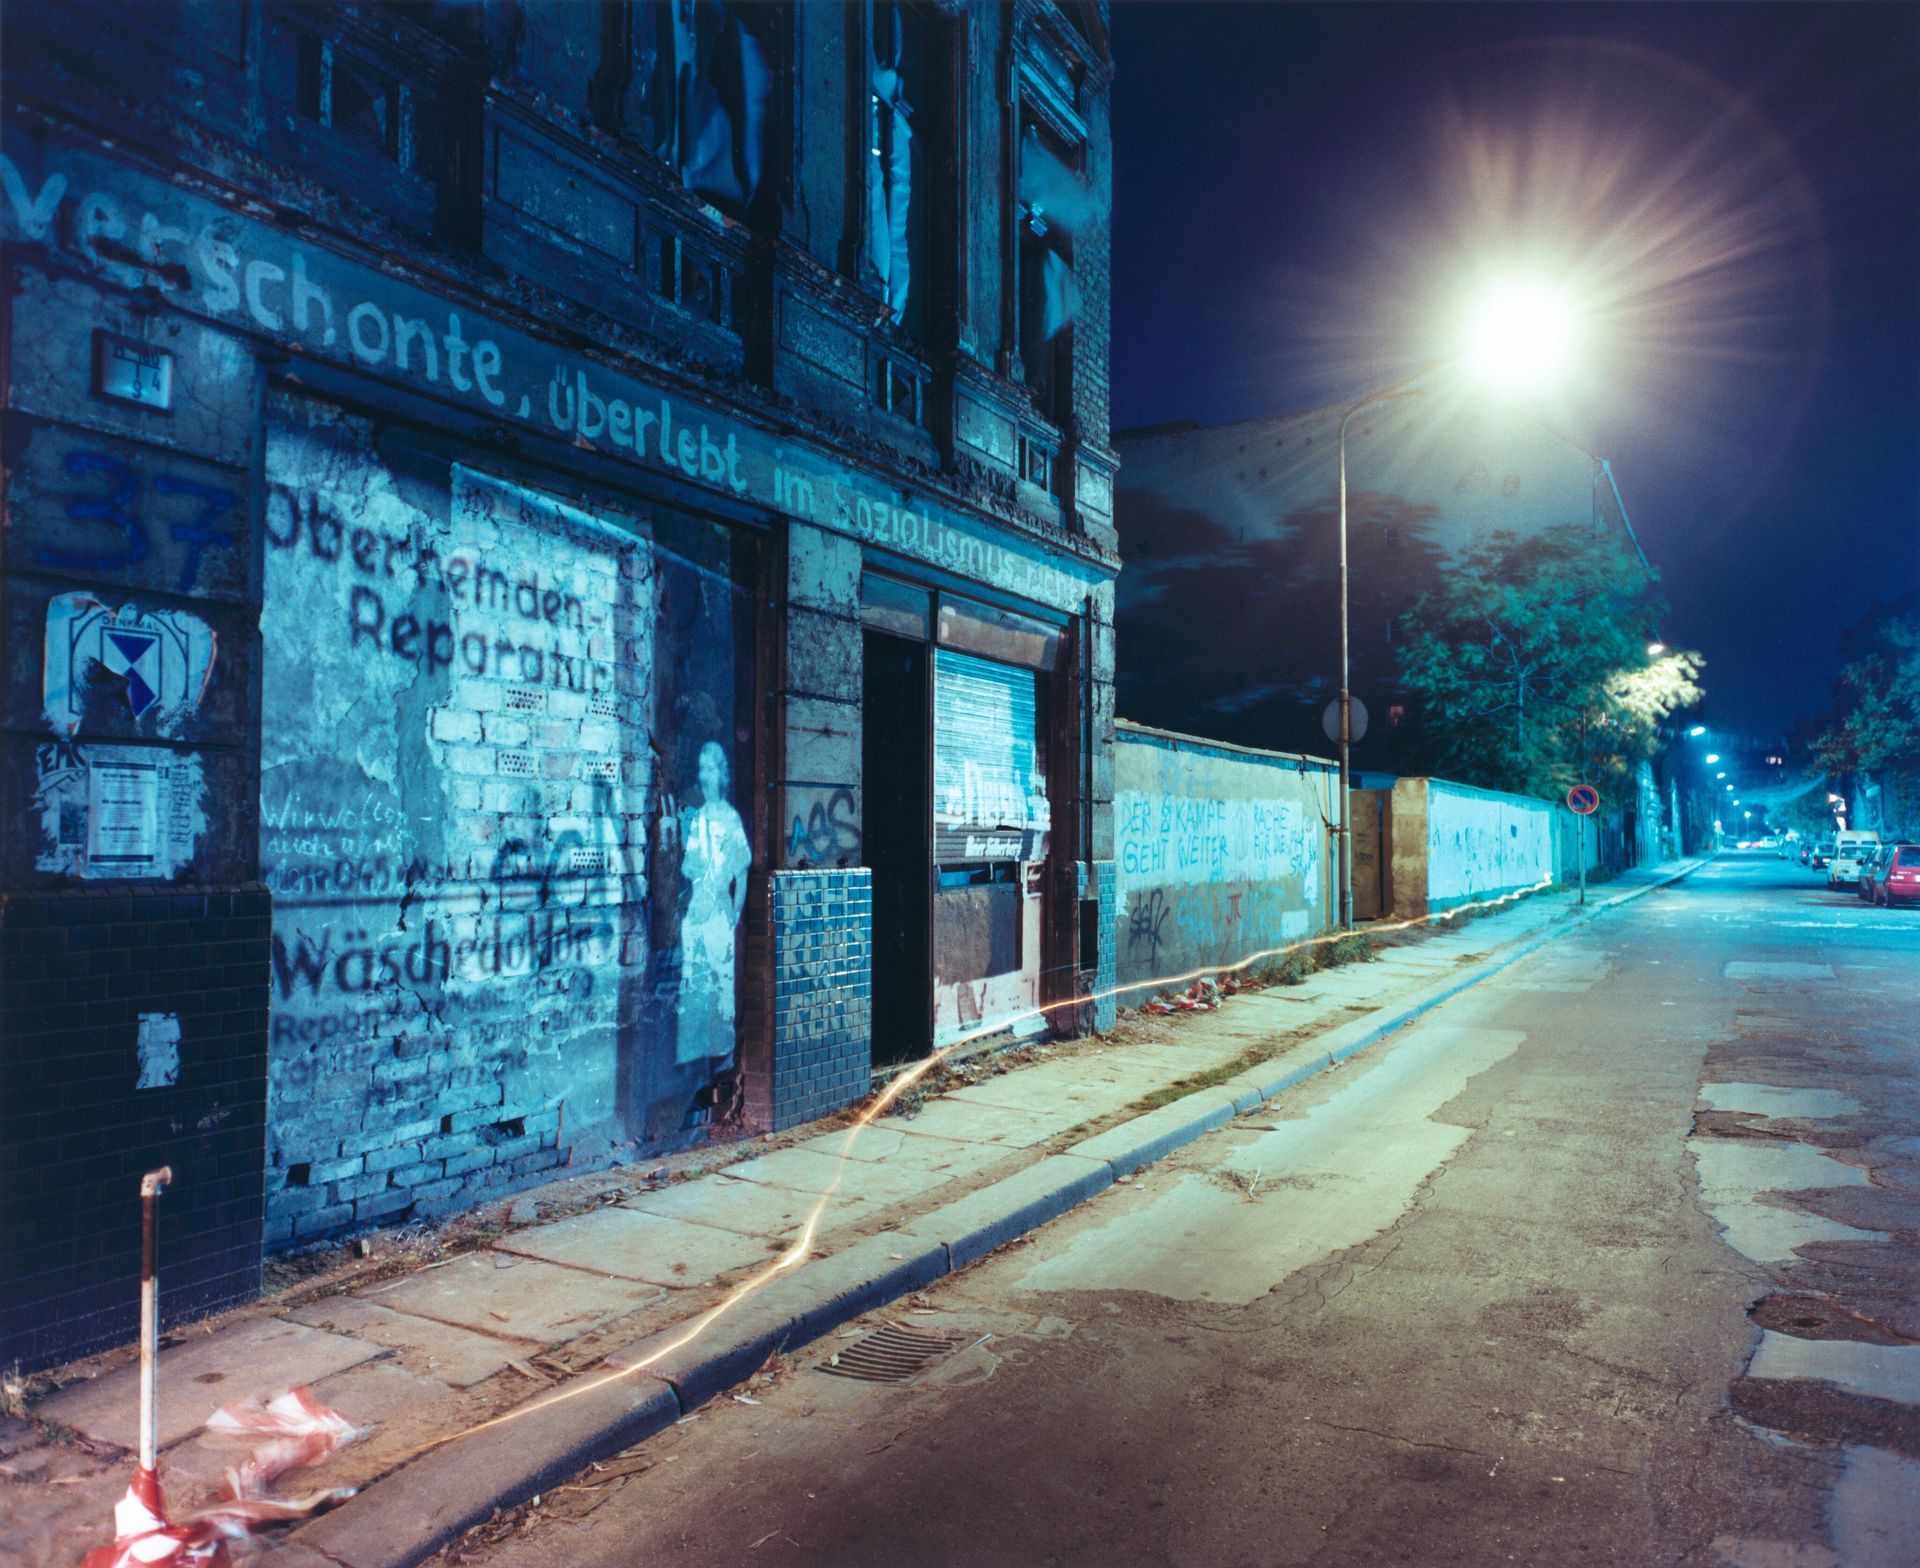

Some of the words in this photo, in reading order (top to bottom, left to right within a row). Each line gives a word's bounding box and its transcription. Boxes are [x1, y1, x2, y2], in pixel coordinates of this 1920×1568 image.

[132, 379, 143, 399] 9
[152, 372, 160, 391] 4
[547, 362, 747, 493] überlebt
[772, 448, 817, 514] im
[33, 451, 236, 592] 37
[102, 615, 161, 632] DENKMAL
[1120, 800, 1152, 837] DER
[1175, 799, 1226, 836] KAMPF
[1122, 837, 1170, 874] GEHT
[1178, 834, 1230, 870] WEITER
